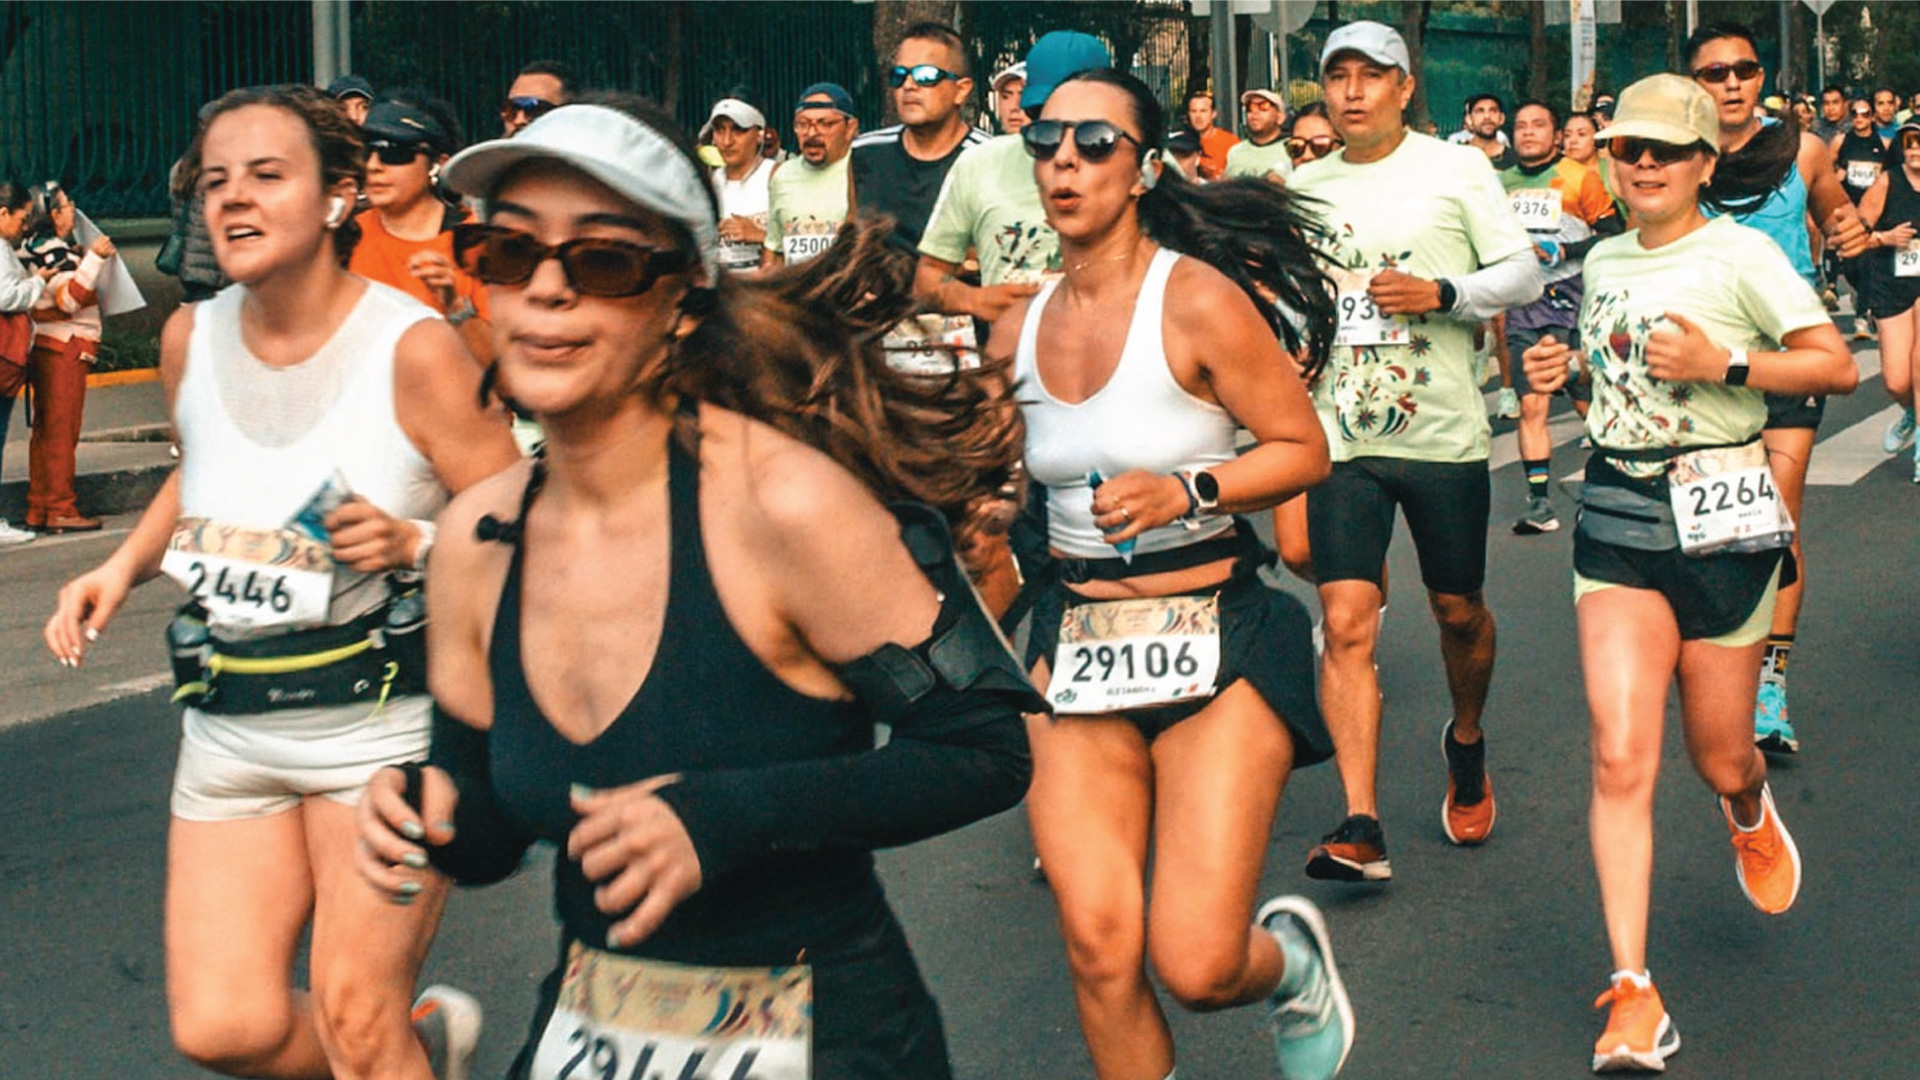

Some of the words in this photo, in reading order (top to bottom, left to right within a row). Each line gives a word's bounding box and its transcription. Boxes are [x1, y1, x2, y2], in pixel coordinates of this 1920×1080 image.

[1513, 201, 1549, 216] 9376
[1688, 472, 1775, 516] 2264
[188, 560, 291, 614] 2446
[1072, 641, 1199, 682] 29106
